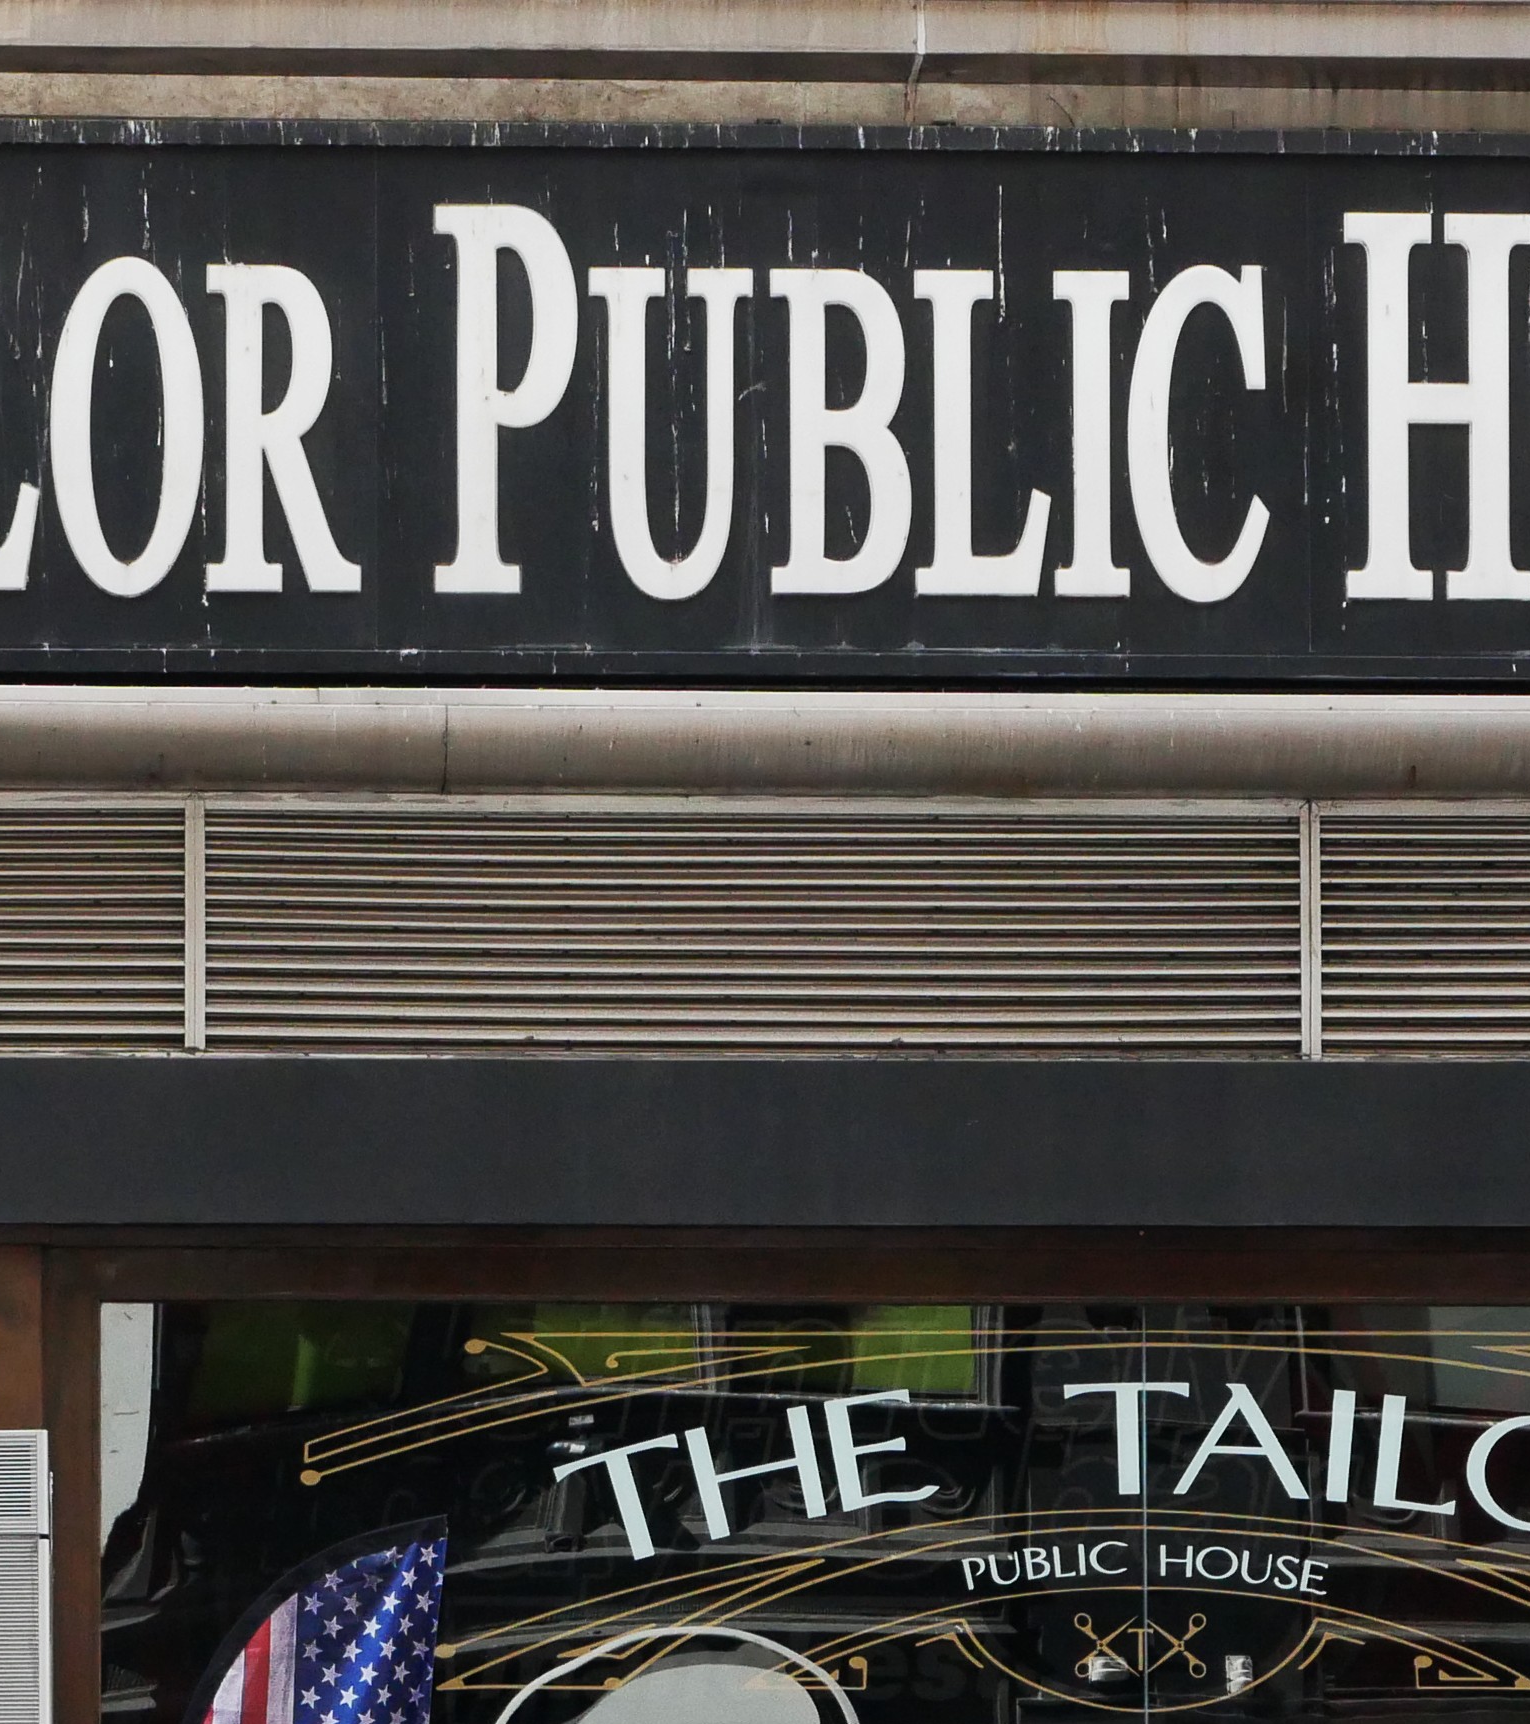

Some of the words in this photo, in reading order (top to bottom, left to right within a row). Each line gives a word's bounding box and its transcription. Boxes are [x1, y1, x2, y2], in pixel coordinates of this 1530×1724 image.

[433, 203, 1270, 602] PUBLIC
[553, 1389, 939, 1562] THE
[962, 1540, 1129, 1591] PUBLIC
[1159, 1545, 1329, 1597] HOUSE
